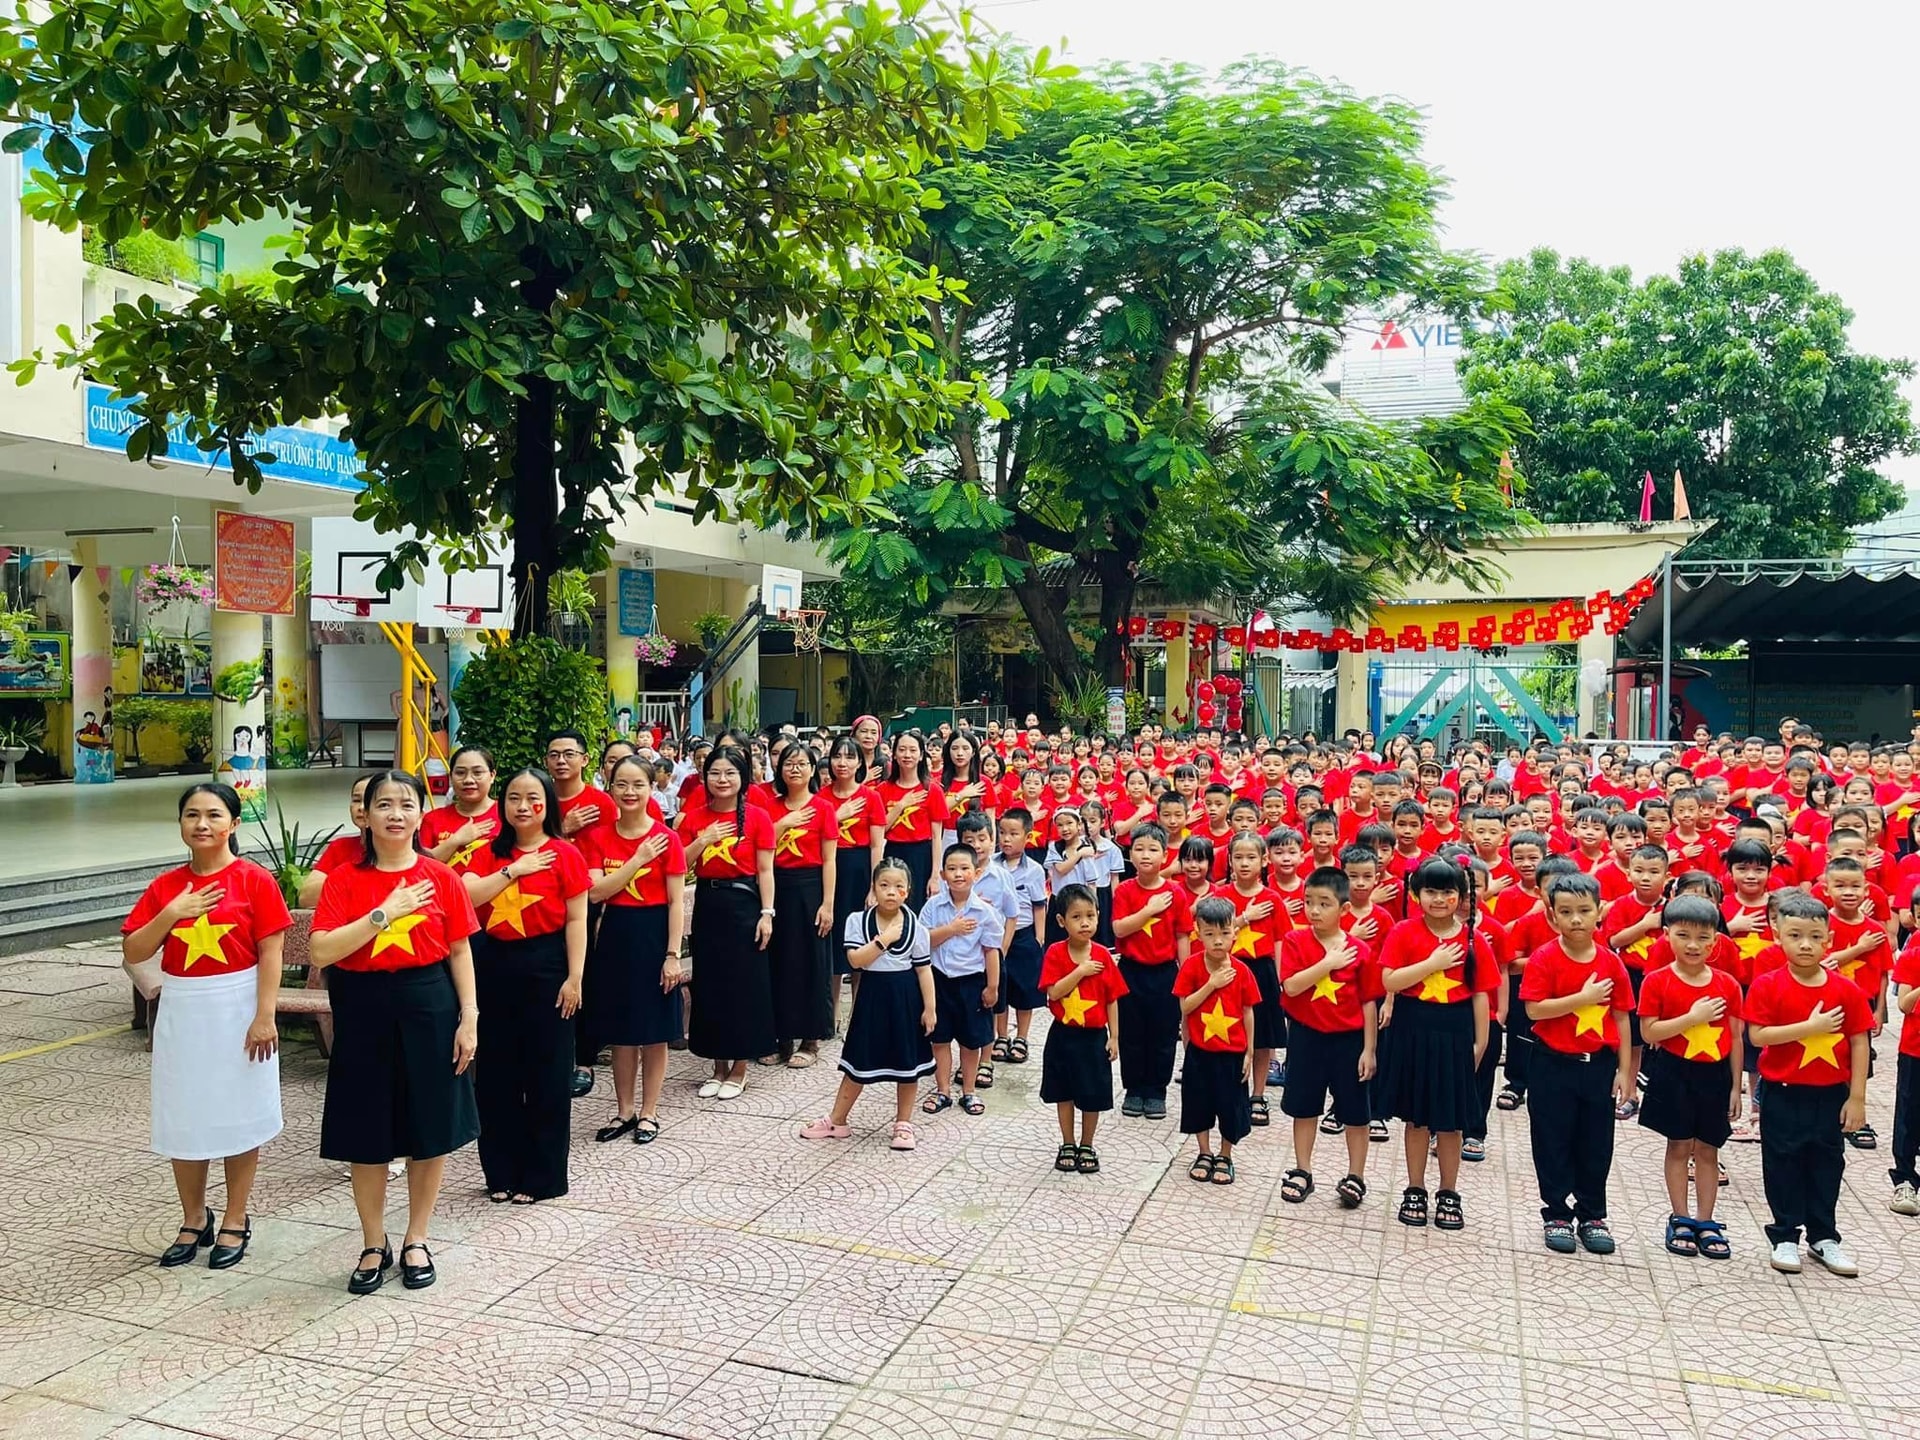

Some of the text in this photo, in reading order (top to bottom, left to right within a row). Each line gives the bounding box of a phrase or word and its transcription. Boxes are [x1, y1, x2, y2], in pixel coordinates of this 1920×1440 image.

[90, 405, 135, 434] CHUNG
[317, 449, 334, 477] HỌC
[337, 454, 362, 480] HẠNH
